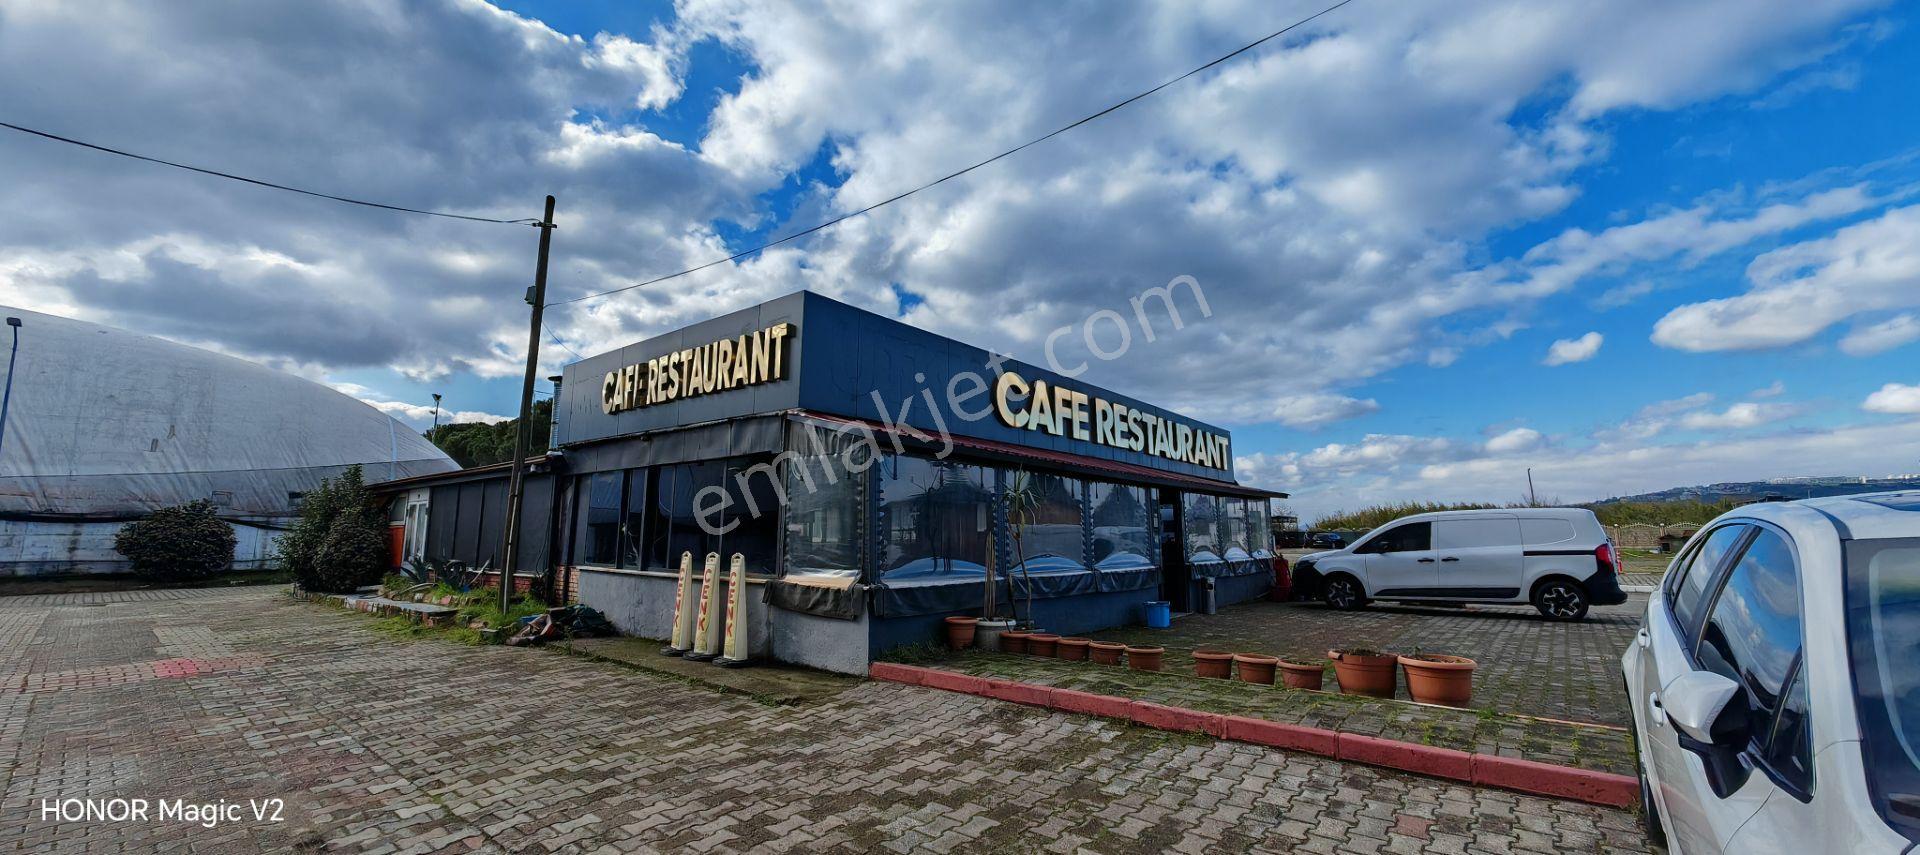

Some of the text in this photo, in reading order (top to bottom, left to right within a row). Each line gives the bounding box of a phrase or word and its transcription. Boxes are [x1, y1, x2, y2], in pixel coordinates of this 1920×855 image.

[646, 322, 789, 405] RESTAURANT
[996, 371, 1229, 471] CAFE RESTAURANT
[698, 568, 712, 631] CENK
[726, 571, 737, 637] CENK
